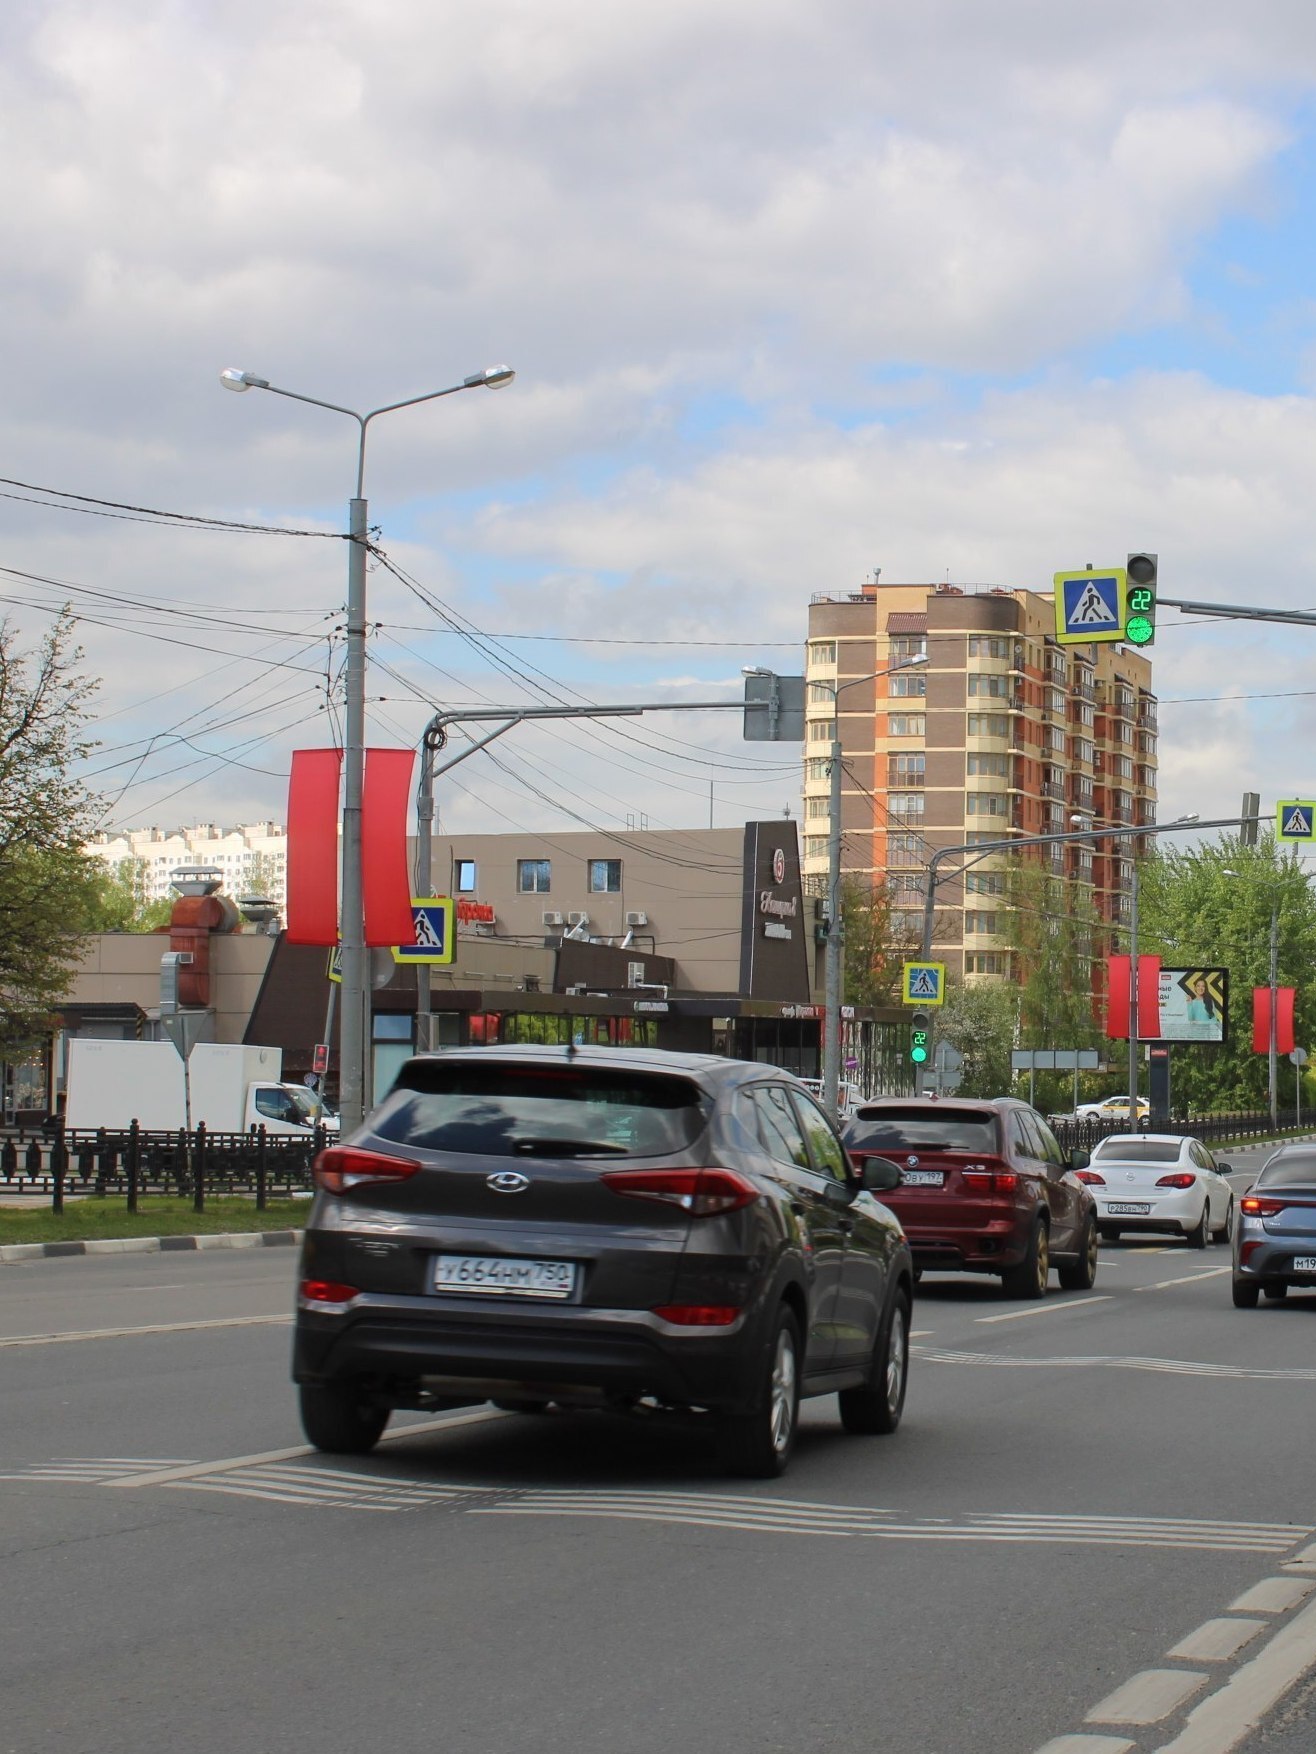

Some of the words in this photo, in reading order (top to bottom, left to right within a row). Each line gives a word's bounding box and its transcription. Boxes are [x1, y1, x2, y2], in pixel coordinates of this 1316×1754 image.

[1131, 590, 1151, 611] 22
[914, 1032, 926, 1045] 22
[535, 1262, 568, 1280] 750
